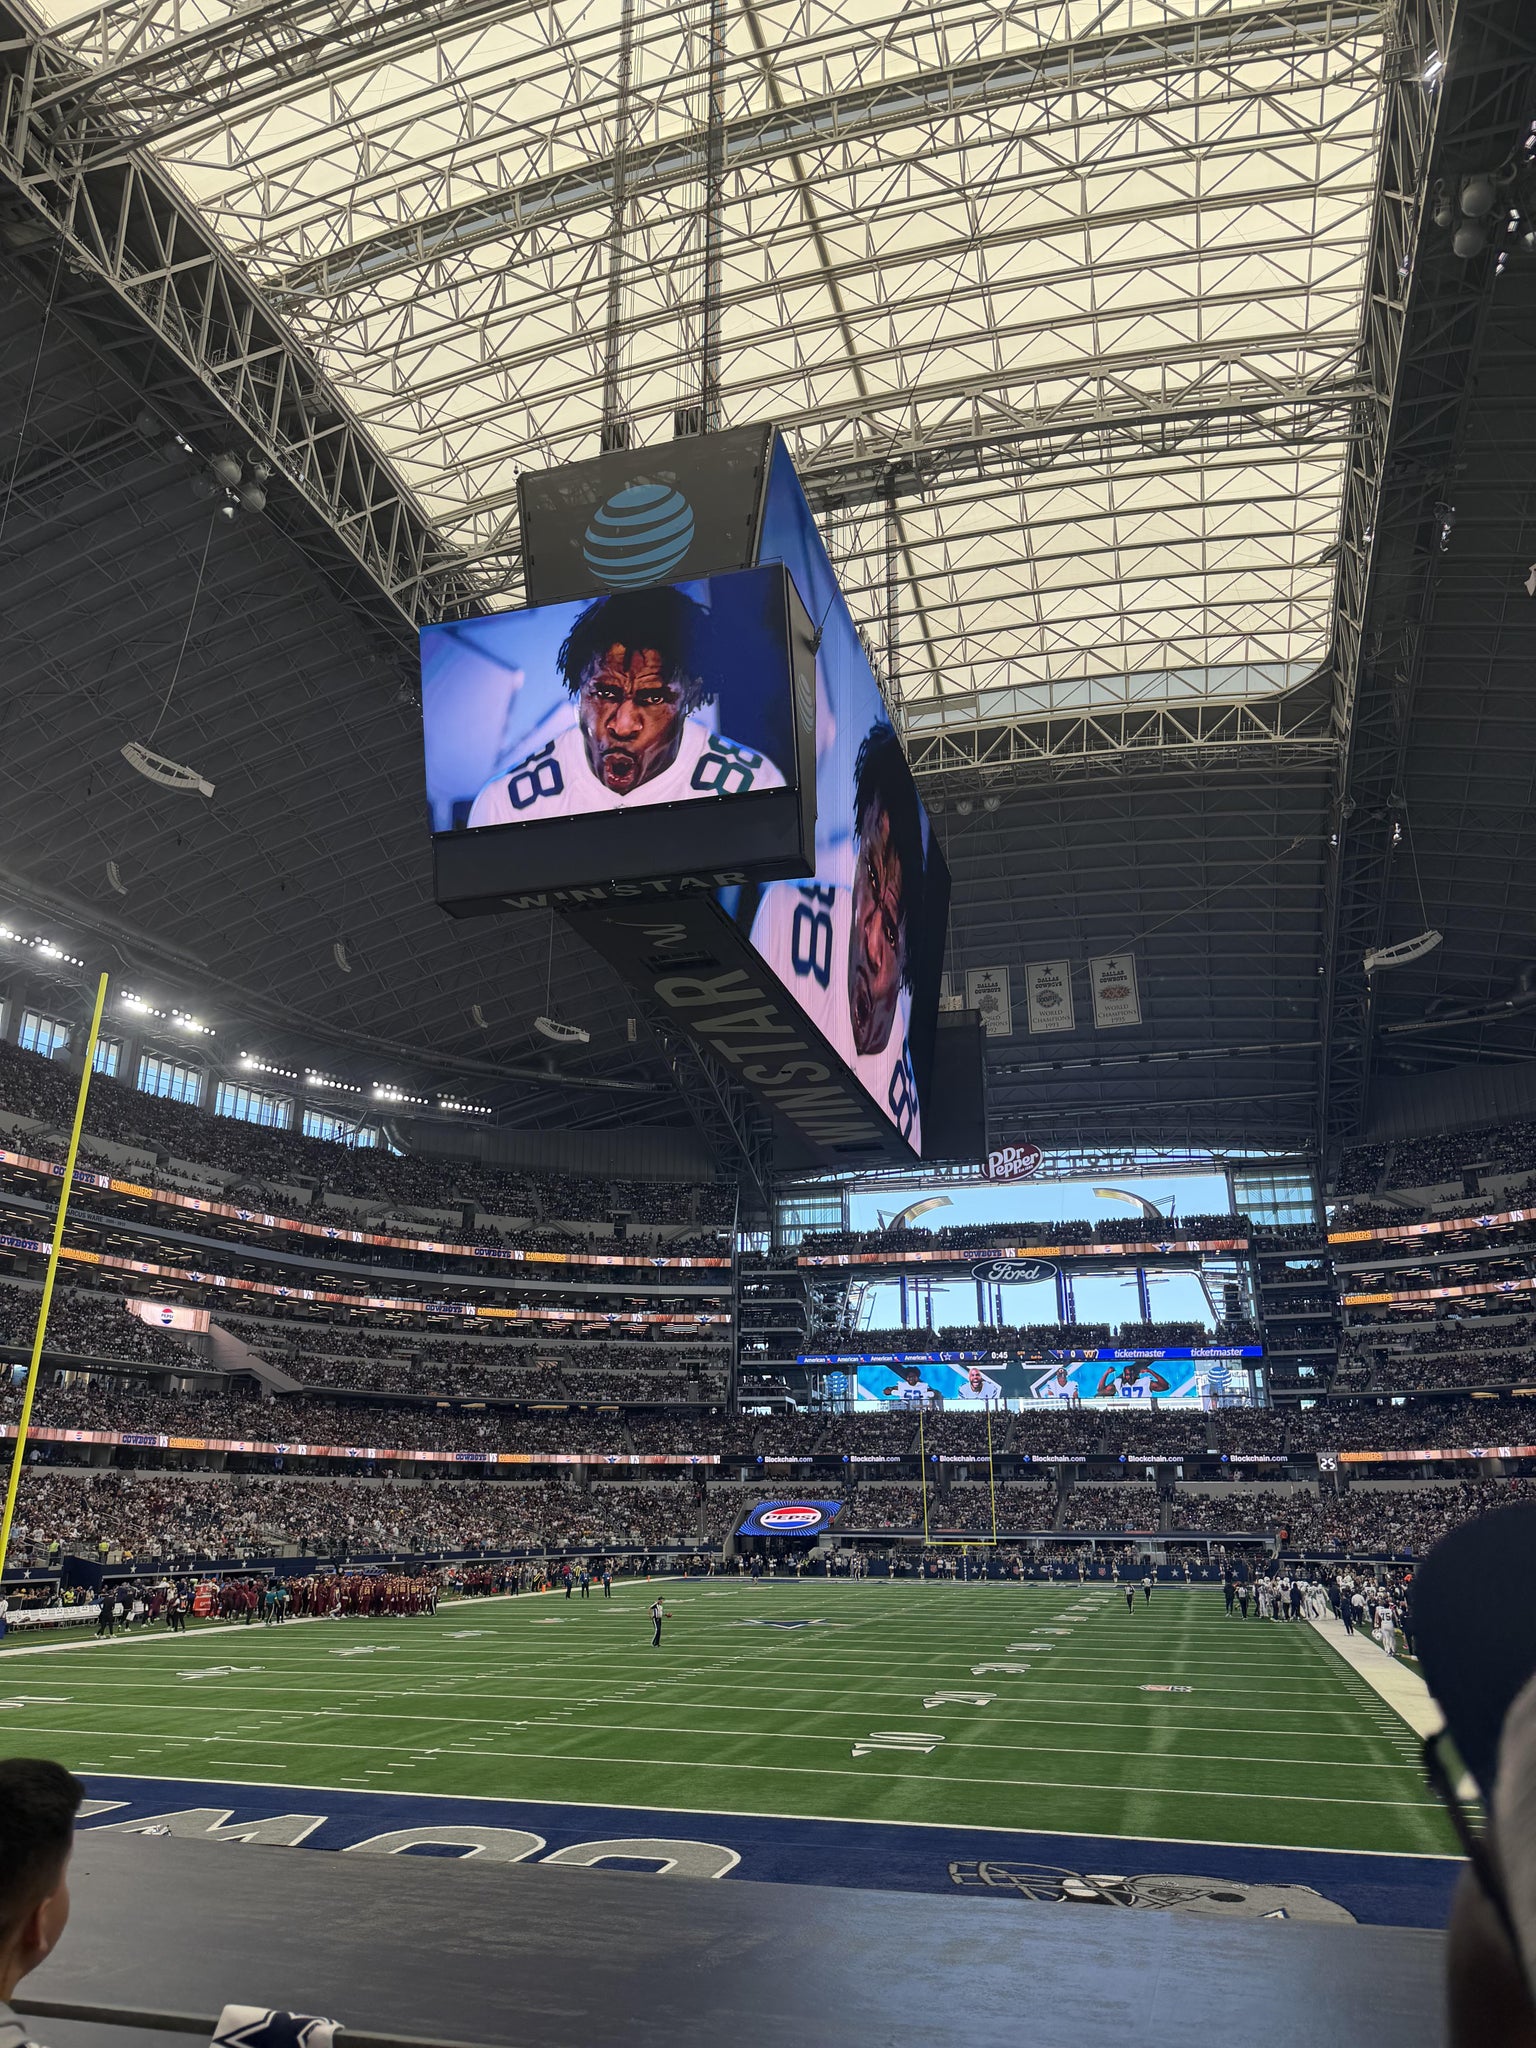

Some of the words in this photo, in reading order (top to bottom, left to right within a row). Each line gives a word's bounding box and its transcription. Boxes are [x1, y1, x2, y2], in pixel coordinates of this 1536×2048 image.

[502, 872, 749, 910] WINSTAR
[1037, 976, 1060, 984] DALLAS
[1099, 976, 1128, 984] COWBOYS
[974, 987, 1001, 995] COWBOYS
[1035, 982, 1063, 990] COWBOYS
[1104, 988, 1127, 999] XXX
[1032, 1015, 1071, 1024] CHAMPIONS
[1097, 1010, 1137, 1019] CHAMPIONS
[654, 968, 885, 1146] WINSTAR
[1003, 1147, 1025, 1163] Dr
[989, 1151, 1039, 1179] Pepper
[53, 1164, 96, 1184] COBOYS
[99, 1174, 110, 1189] VS
[110, 1178, 154, 1199] COMMANDERS
[54, 1205, 87, 1219] DARCUS
[1510, 1210, 1524, 1222] VS
[264, 1214, 275, 1227] VS
[352, 1231, 363, 1243] VS
[1327, 1230, 1372, 1244] OMMANDERS
[0, 1235, 39, 1251] OWBOYS
[59, 1247, 100, 1262] OMMANDERS
[1186, 1240, 1200, 1251] VS
[474, 1248, 512, 1259] COWBOYS
[514, 1250, 525, 1261] VS
[525, 1251, 567, 1262] COMMANDERS
[963, 1249, 1003, 1259] COWBOYS
[1005, 1248, 1016, 1258] VS
[1017, 1246, 1061, 1256] COMMANDERS
[680, 1257, 692, 1267] VS
[988, 1261, 1040, 1280] Ford
[303, 1289, 314, 1300] VS
[1345, 1293, 1393, 1305] COMMANDERS
[425, 1303, 463, 1314] COWBOYS
[466, 1305, 476, 1315] VS
[477, 1307, 517, 1318] COMMANDERS
[632, 1313, 643, 1323] VS
[959, 1351, 965, 1360] 0
[991, 1351, 1008, 1359] 0:45
[1070, 1350, 1076, 1358] 0
[1114, 1349, 1166, 1358] ticketmaster
[1191, 1347, 1244, 1357] ticketmaster
[1121, 1386, 1143, 1398] 97
[122, 1434, 157, 1445] COWBOYS
[169, 1437, 206, 1449] COMMANDERS
[1340, 1451, 1383, 1461] COMMANDERS
[1499, 1447, 1511, 1457] VS
[850, 1455, 901, 1463] Blockchain.com
[1031, 1455, 1086, 1463] Blockchain.com
[1230, 1454, 1288, 1462] Blockchain.com
[1320, 1457, 1336, 1470] 25
[765, 1513, 818, 1522] PEPSI
[1380, 1612, 1391, 1622] 75
[852, 1731, 946, 1757] 10
